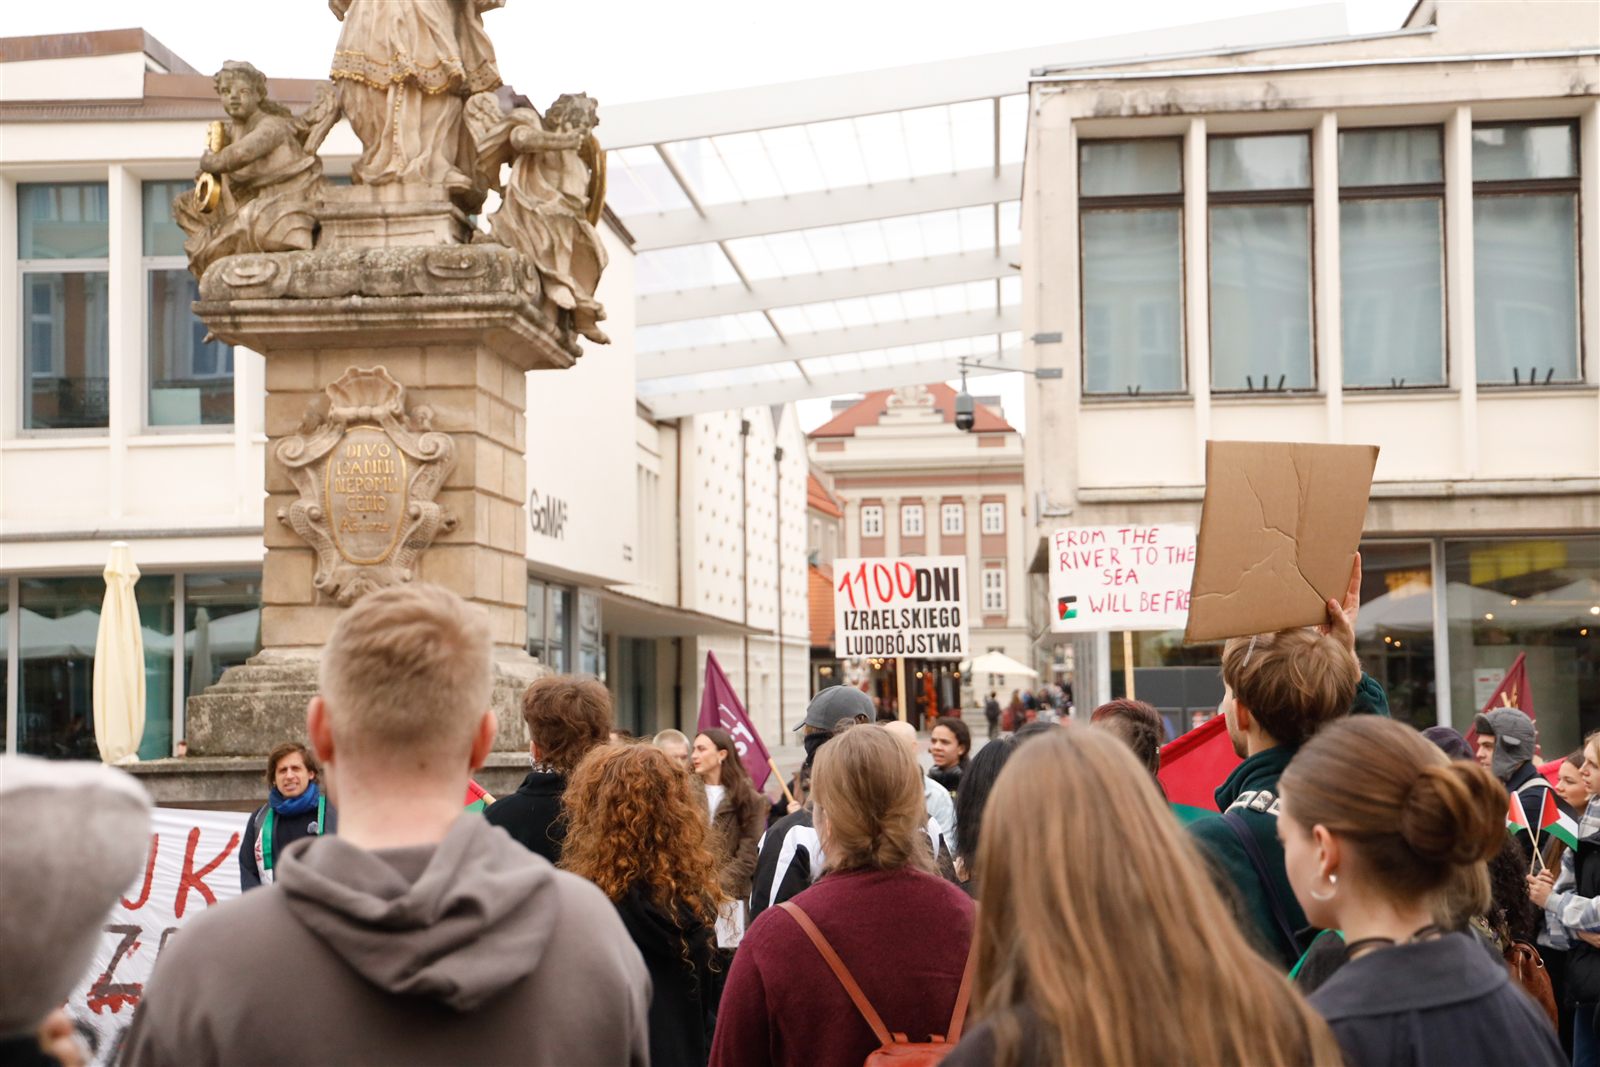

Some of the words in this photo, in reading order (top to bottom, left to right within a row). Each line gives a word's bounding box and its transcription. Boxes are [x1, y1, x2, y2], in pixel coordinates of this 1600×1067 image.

[346, 443, 391, 457] DIVO
[1055, 530, 1106, 550] FROM
[1118, 528, 1159, 545] THE
[1060, 548, 1121, 571] RIVER
[1131, 546, 1158, 565] TO
[1164, 545, 1195, 564] THE
[838, 562, 916, 608] 1100
[915, 567, 960, 602] DNI
[1103, 568, 1138, 586] SEA
[1088, 592, 1133, 613] WILL
[1139, 591, 1160, 612] BE
[1164, 589, 1191, 613] FRE
[844, 606, 961, 630] IZRAELSKIEGO
[846, 630, 962, 655] LUDOBÓJSTWA
